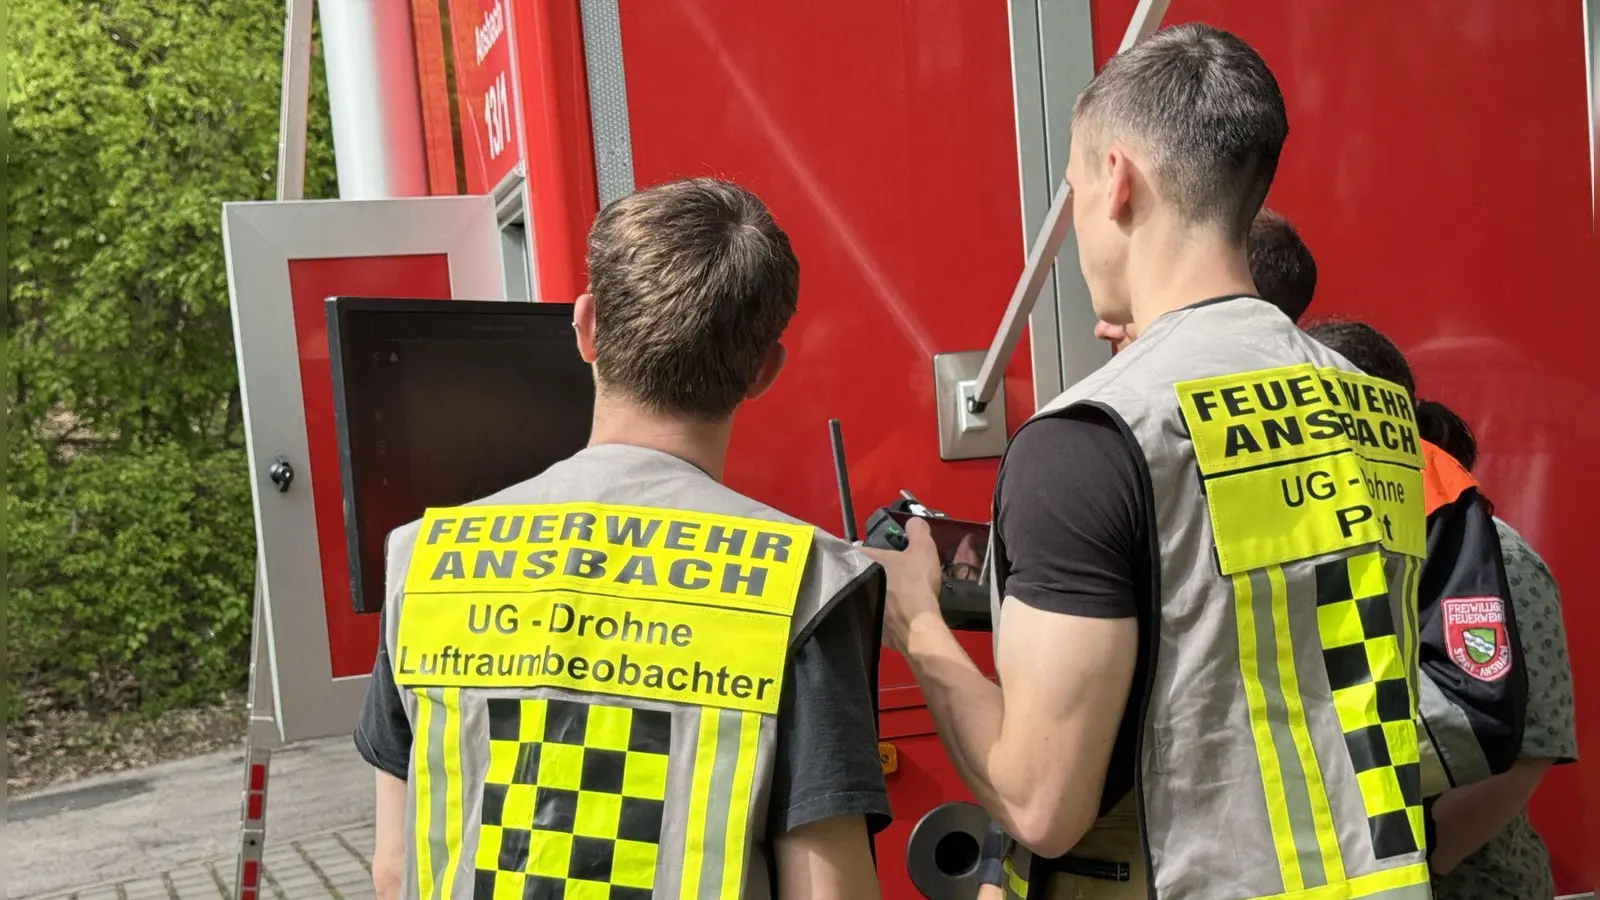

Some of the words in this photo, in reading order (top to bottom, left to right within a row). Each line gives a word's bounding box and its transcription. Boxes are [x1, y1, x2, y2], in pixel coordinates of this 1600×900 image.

[484, 70, 511, 160] 13/1
[1191, 375, 1414, 423] FEUERWEHR
[1224, 409, 1417, 458] ANSBACH
[426, 512, 793, 563] FEUERWEHR
[430, 547, 769, 597] ANSBACH
[399, 645, 774, 701] Luftraumbeobachter
